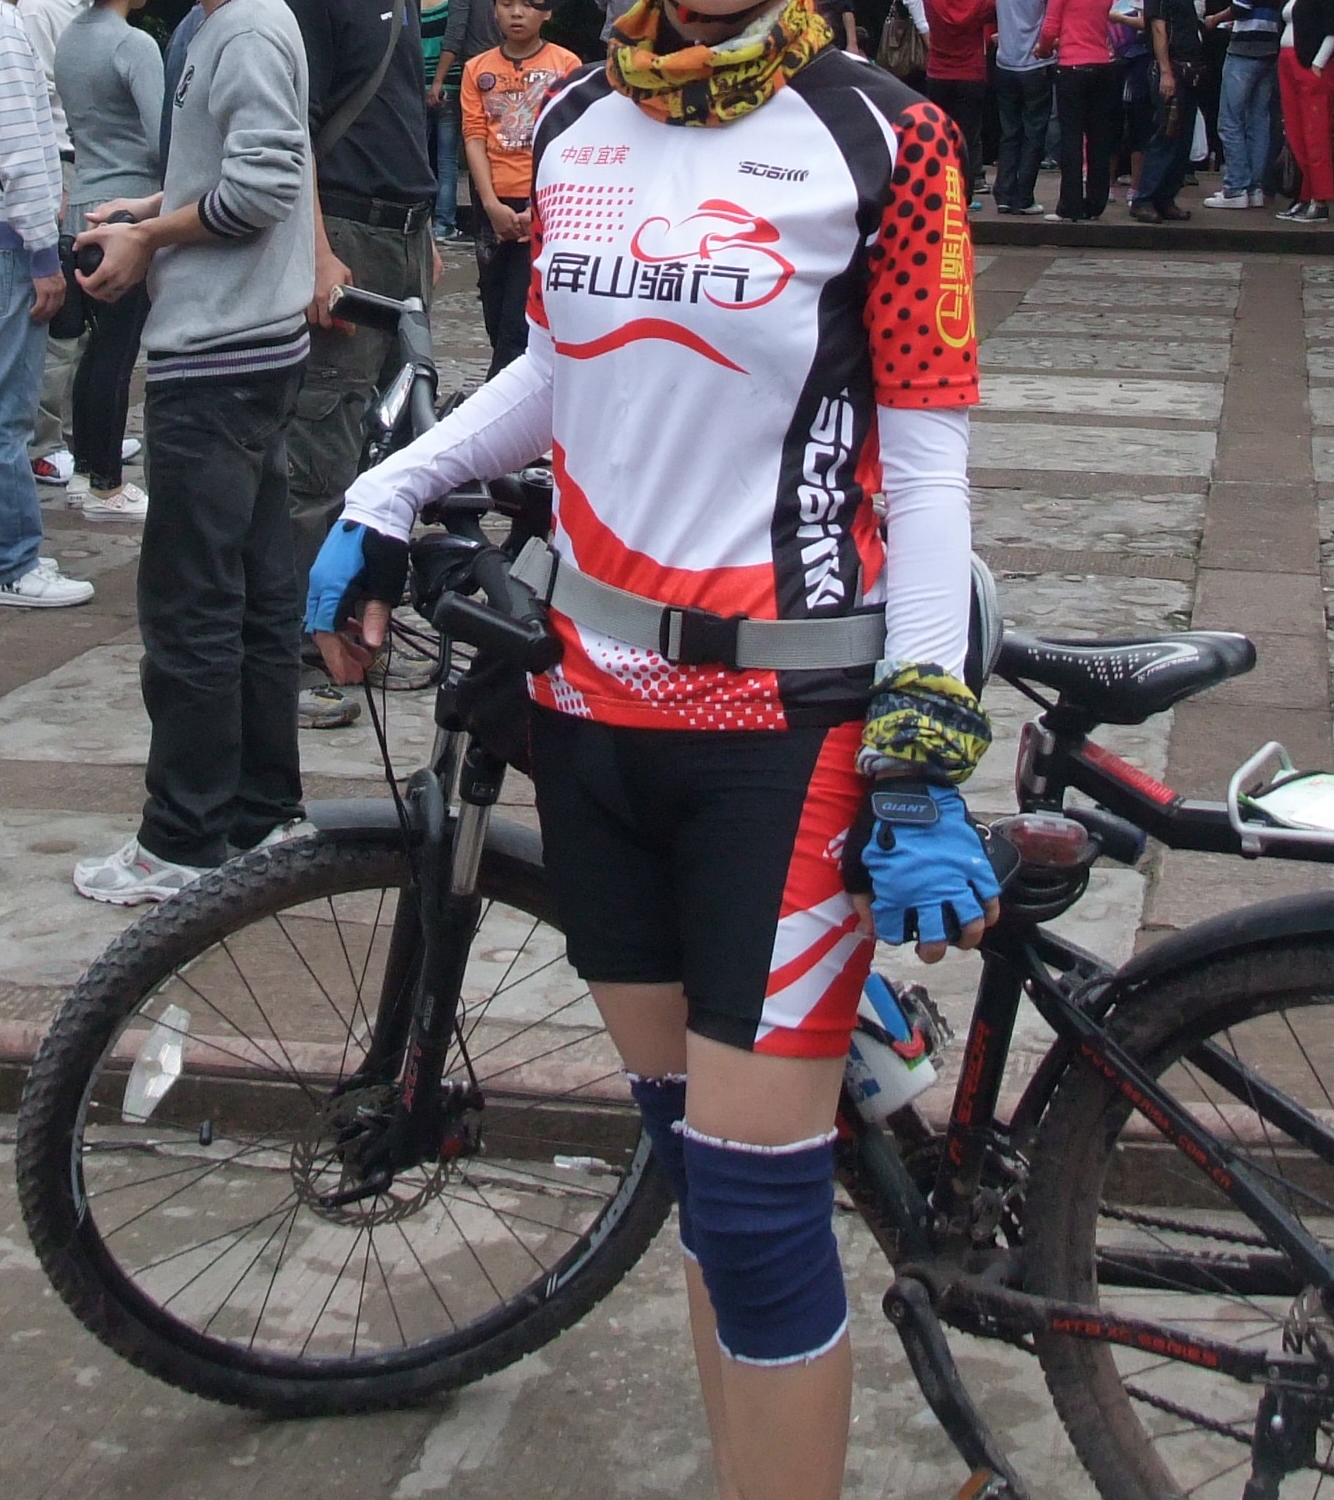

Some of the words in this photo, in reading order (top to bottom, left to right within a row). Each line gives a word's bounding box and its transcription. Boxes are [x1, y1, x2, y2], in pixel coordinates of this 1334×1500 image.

[560, 146, 595, 165] 中国
[593, 144, 630, 165] 宜宾
[545, 251, 750, 304] 屏山骑行
[881, 802, 928, 813] GIANT
[1053, 1318, 1101, 1336] MTB
